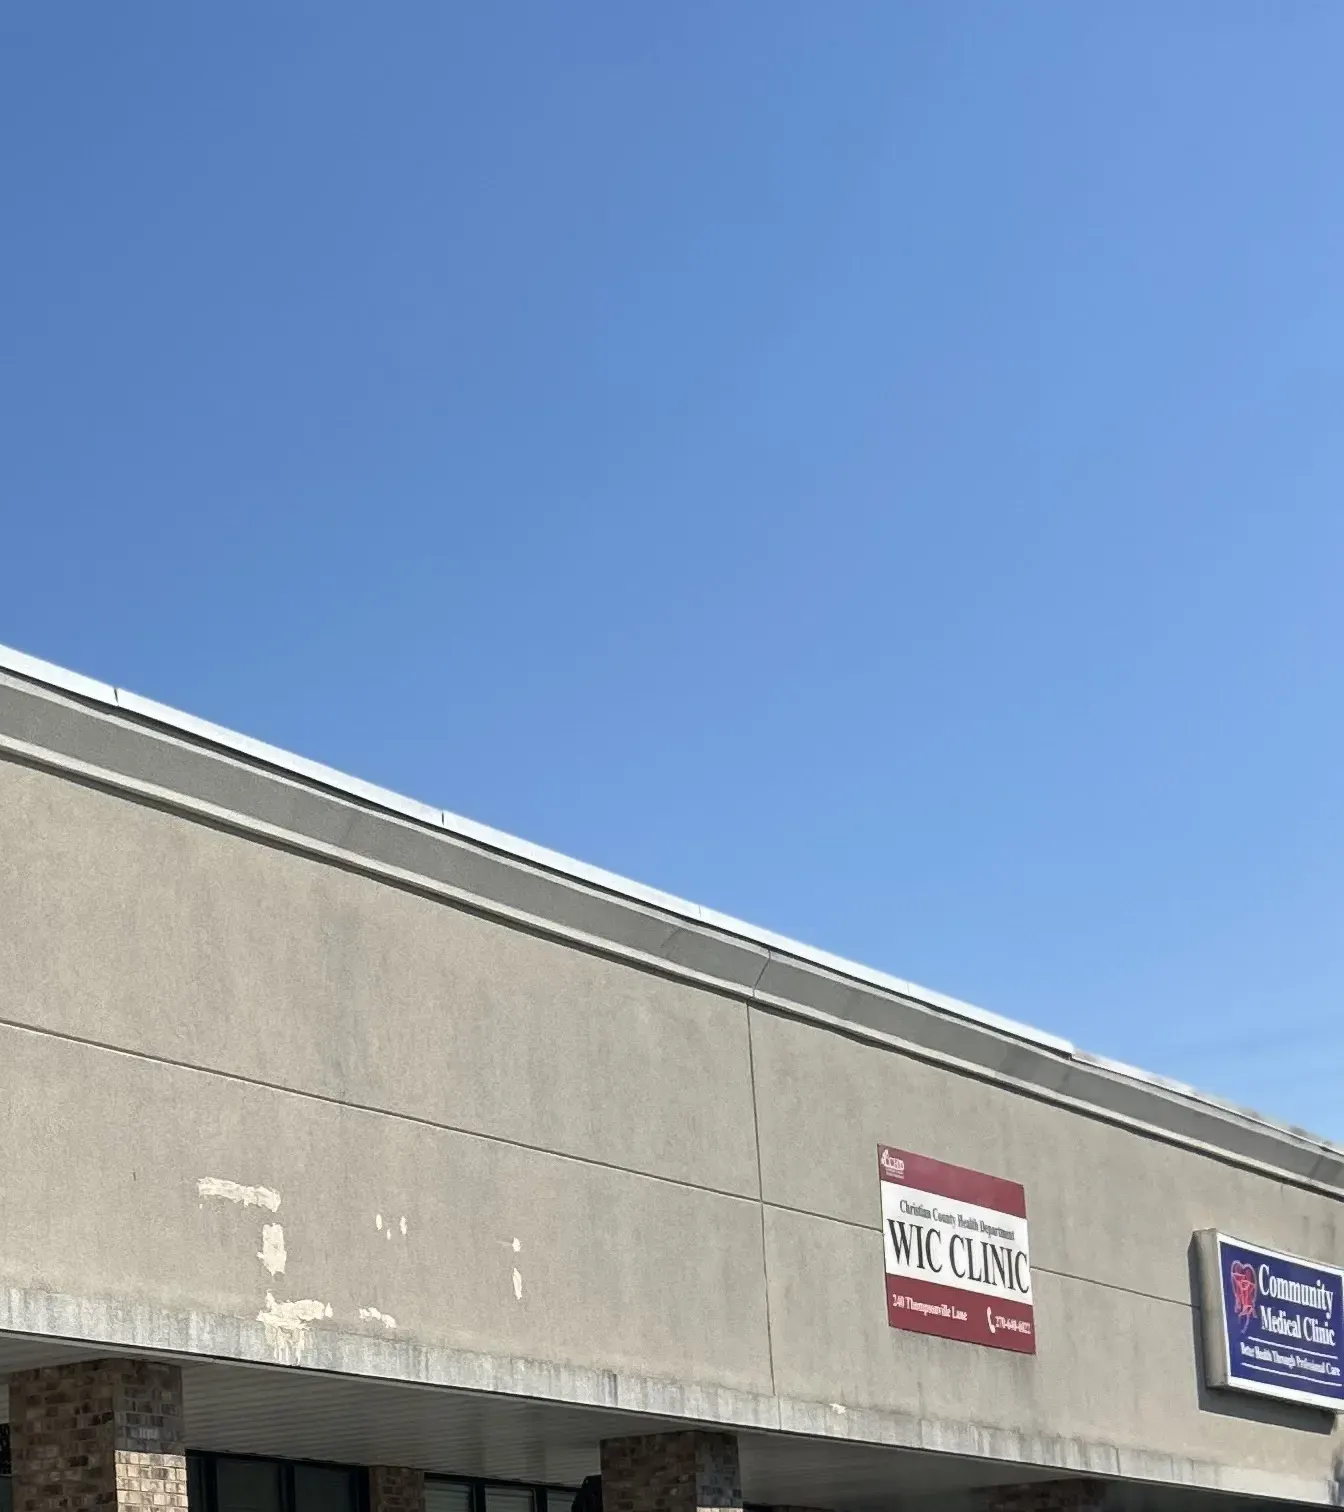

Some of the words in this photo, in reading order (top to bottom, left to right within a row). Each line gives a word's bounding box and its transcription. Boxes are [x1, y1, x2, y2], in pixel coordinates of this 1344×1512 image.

[899, 1199, 931, 1219] Christian
[932, 1207, 956, 1229] County
[957, 1213, 979, 1231] Health
[980, 1220, 1015, 1240] Department
[887, 1218, 943, 1273] WIC
[949, 1234, 1030, 1294] CLINIC
[1259, 1263, 1333, 1320] Community
[951, 1305, 968, 1321] Lane
[1260, 1305, 1302, 1338] Medical
[1303, 1316, 1336, 1346] Clinic
[1326, 1362, 1341, 1376] Care
